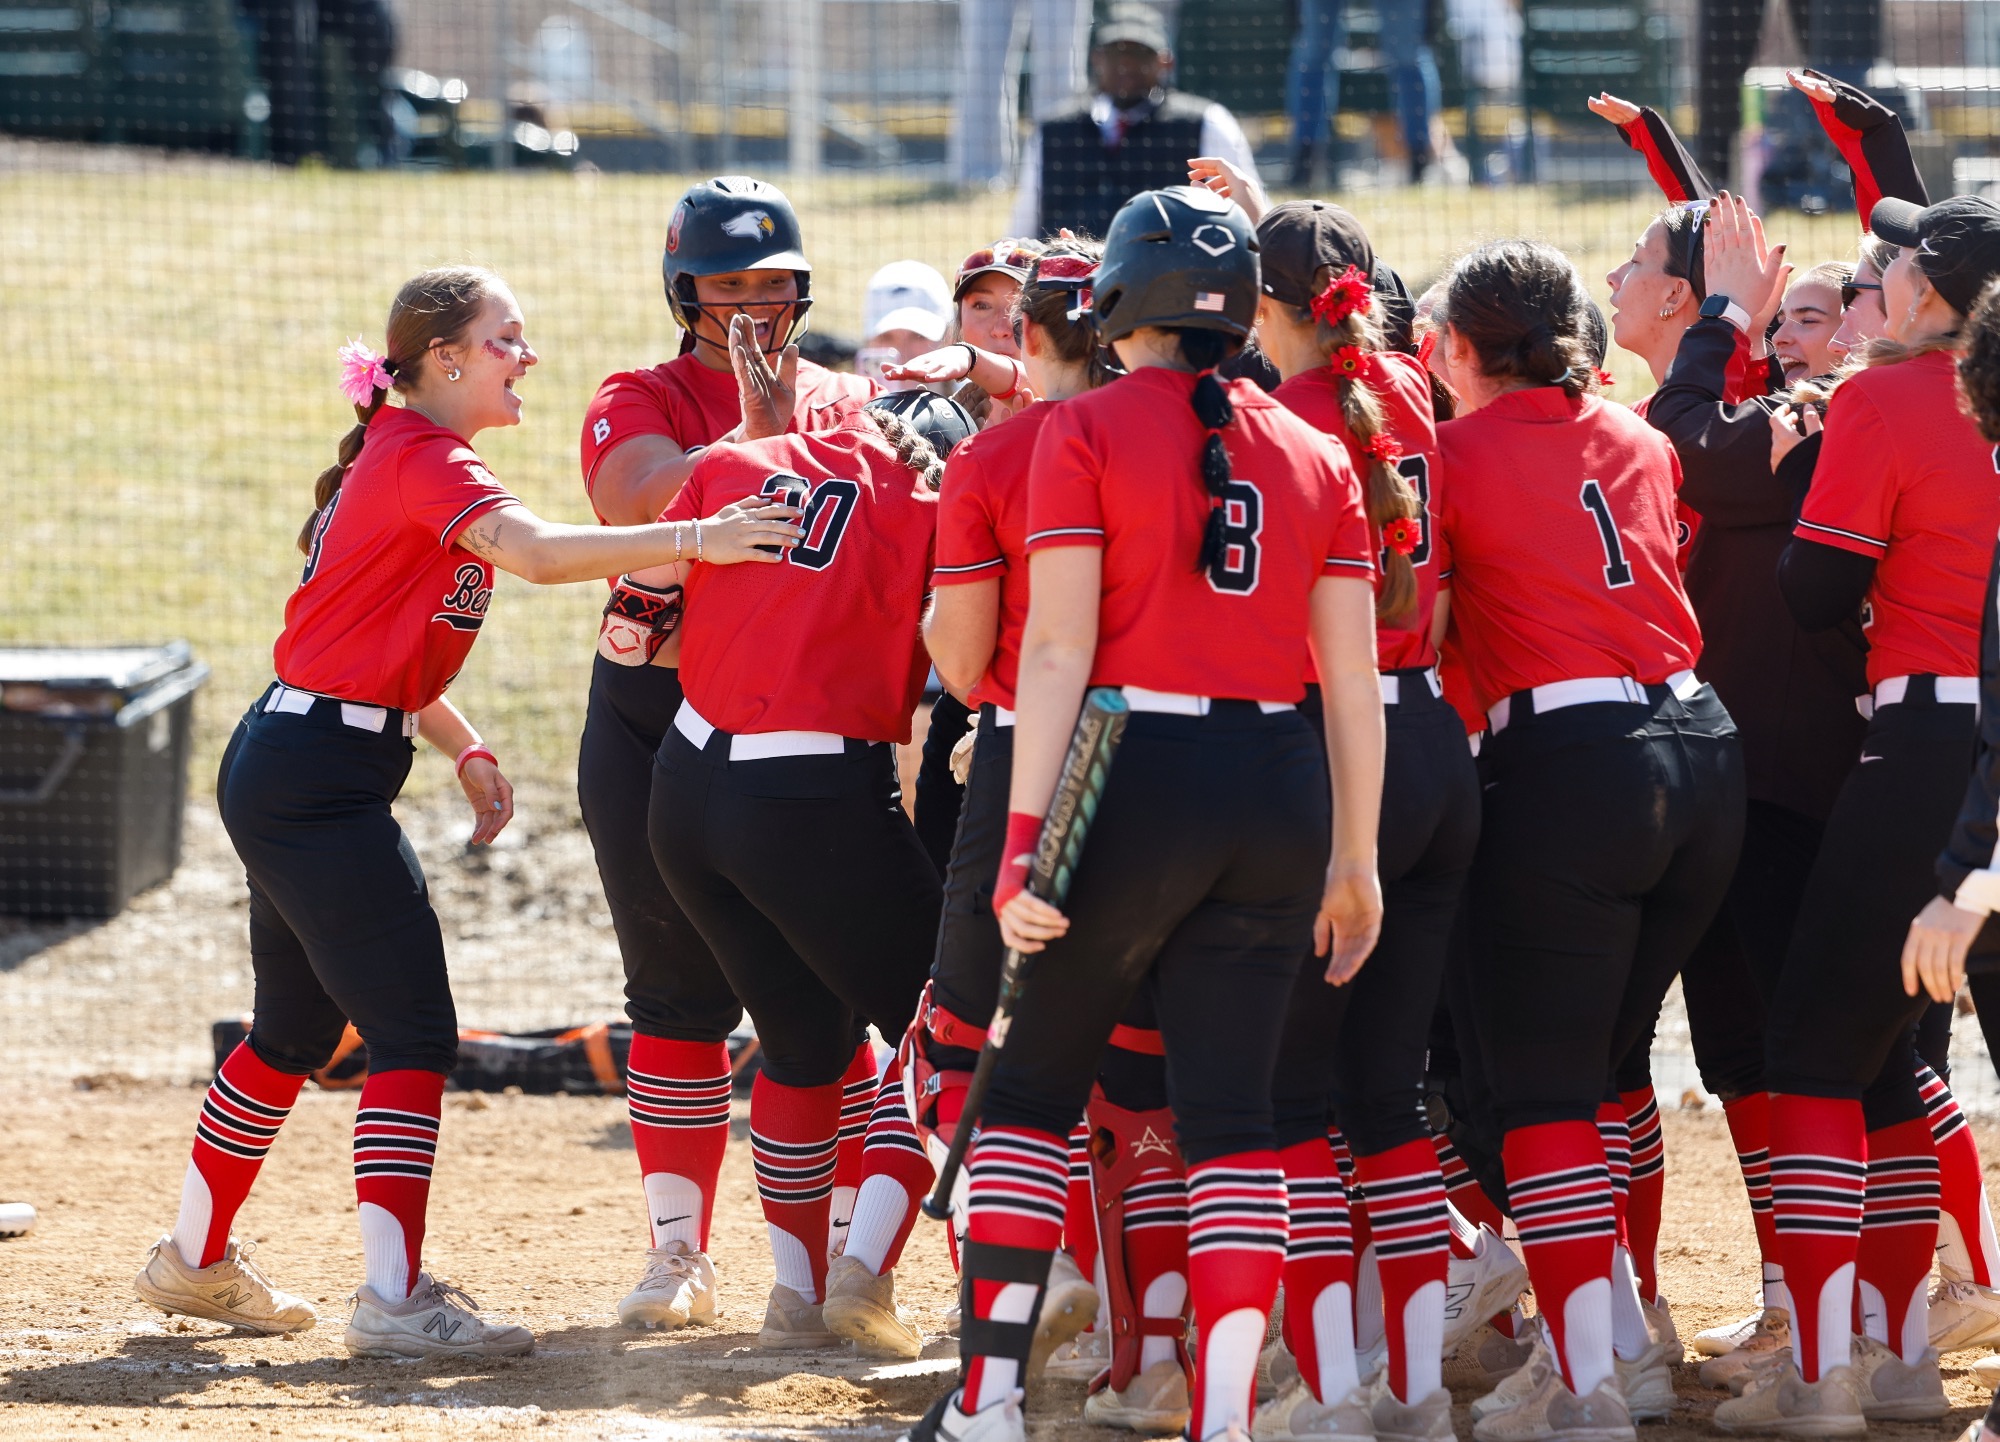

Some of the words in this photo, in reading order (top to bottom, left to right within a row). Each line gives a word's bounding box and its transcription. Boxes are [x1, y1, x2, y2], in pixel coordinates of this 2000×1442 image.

[592, 417, 612, 446] B
[1206, 480, 1263, 596] 8
[1579, 479, 1635, 589] 1
[213, 1283, 253, 1309] N
[423, 1311, 462, 1341] N
